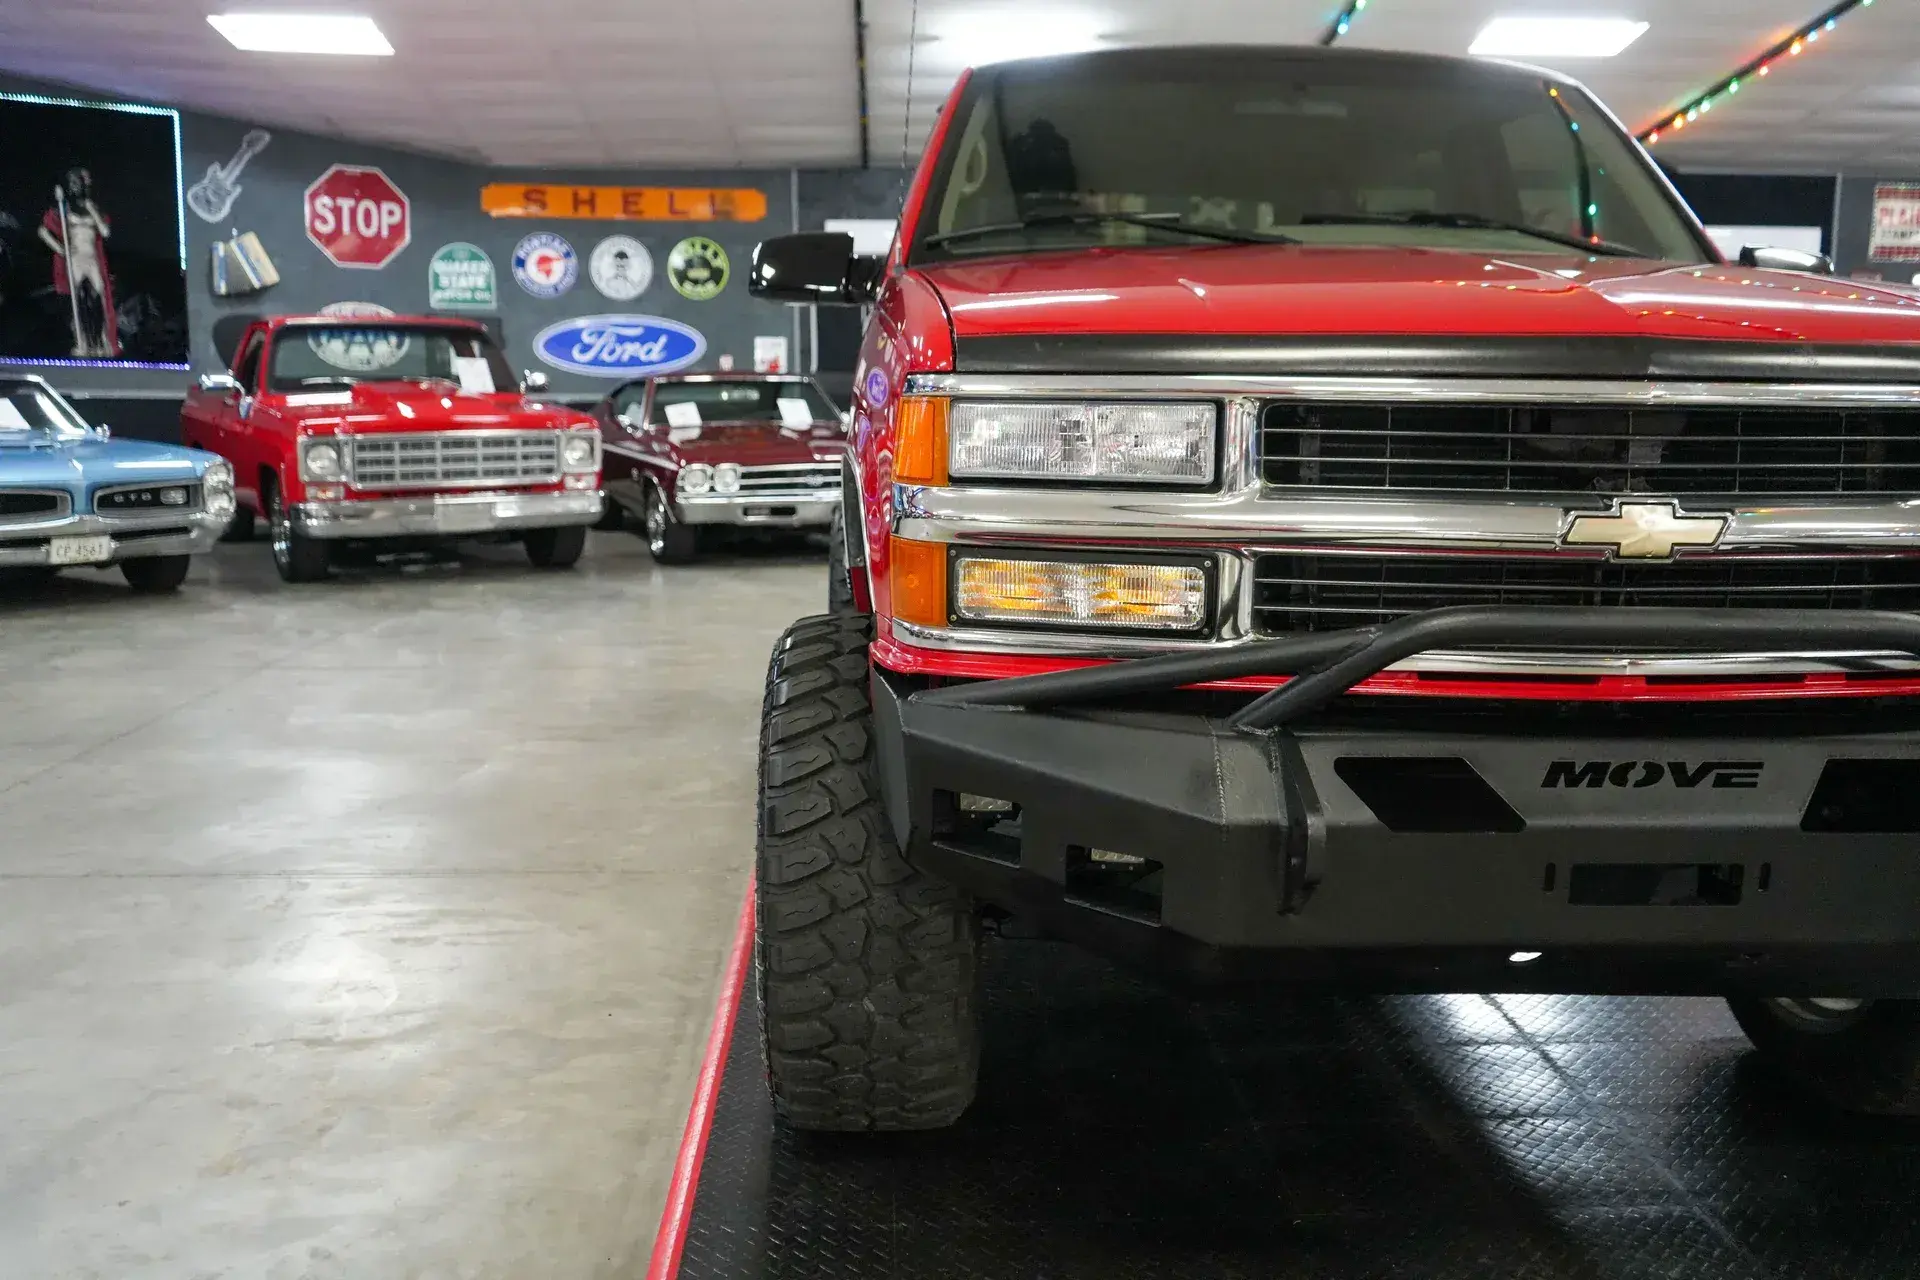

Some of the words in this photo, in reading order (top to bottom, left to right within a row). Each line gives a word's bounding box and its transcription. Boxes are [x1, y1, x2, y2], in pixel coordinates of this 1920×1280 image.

[313, 194, 403, 239] STOP
[522, 187, 730, 218] SHELL
[571, 325, 668, 363] Ford
[1540, 761, 1765, 788] MOVE
